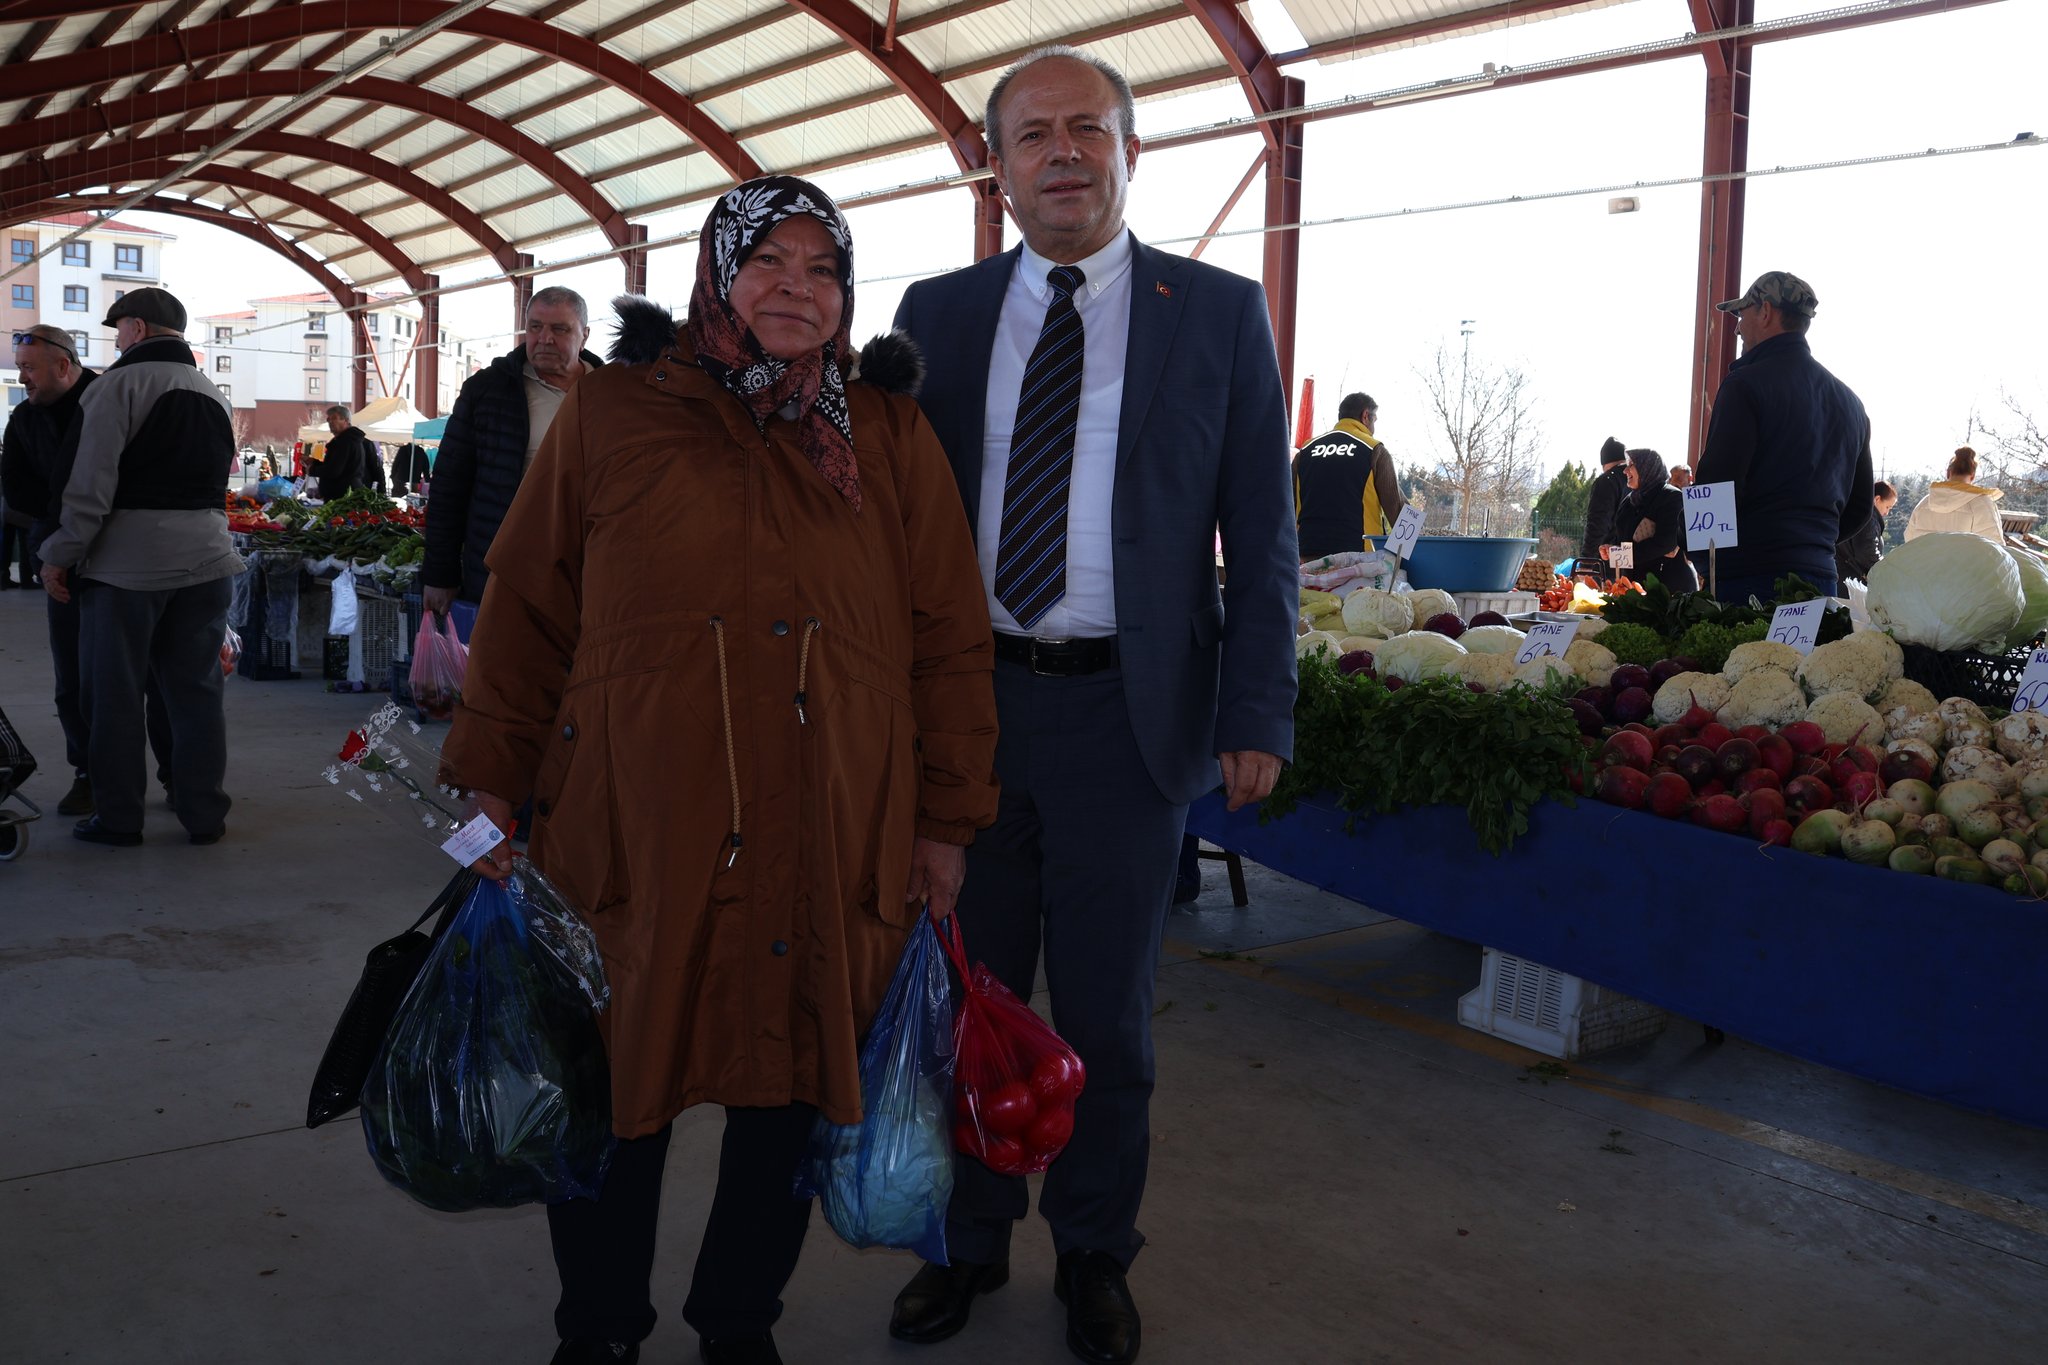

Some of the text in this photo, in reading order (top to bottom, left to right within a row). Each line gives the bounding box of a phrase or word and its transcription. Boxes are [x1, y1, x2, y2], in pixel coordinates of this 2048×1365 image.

[1311, 443, 1357, 458] opet
[1395, 519, 1415, 541] 50
[1688, 511, 1735, 532] 40 TL
[1779, 605, 1809, 617] TANE
[1532, 625, 1564, 636] TANE
[1773, 625, 1800, 646] 50
[2013, 680, 2048, 713] 60
